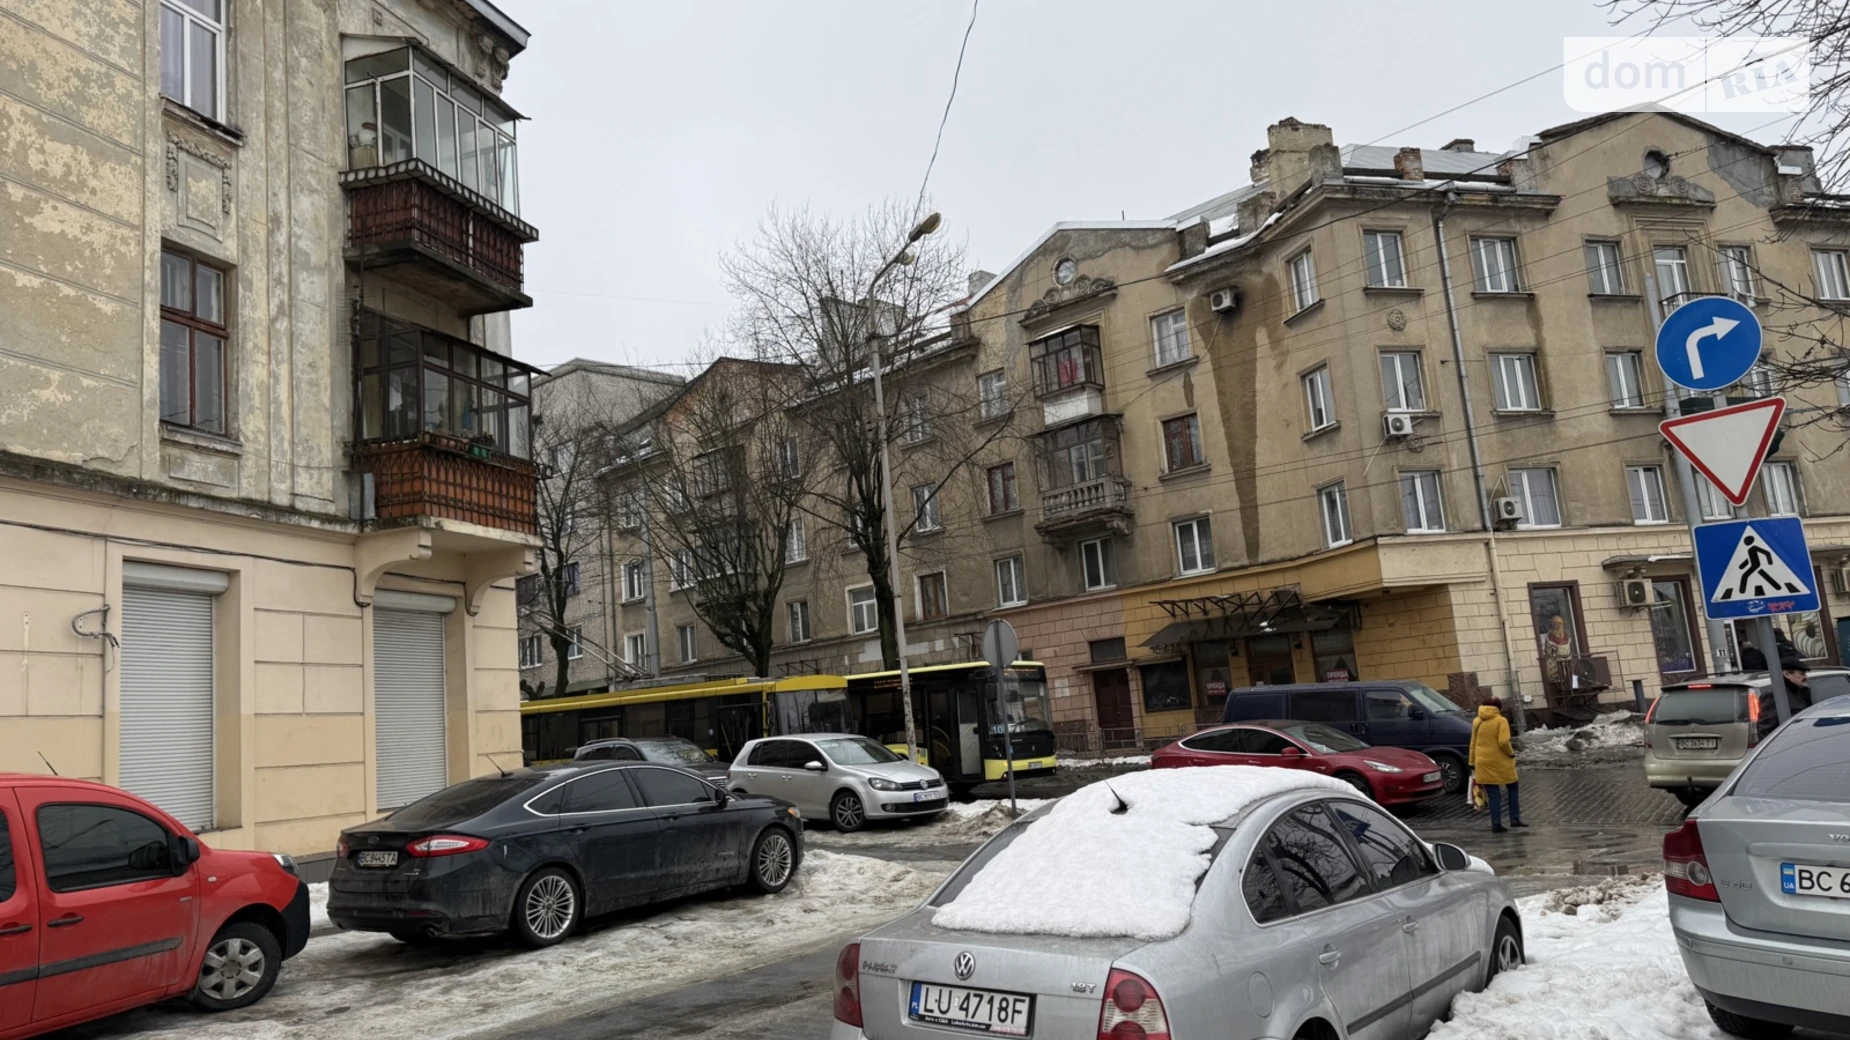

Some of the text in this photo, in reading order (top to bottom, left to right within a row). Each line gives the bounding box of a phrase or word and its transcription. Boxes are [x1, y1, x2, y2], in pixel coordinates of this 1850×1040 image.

[1326, 671, 1349, 679] ОРЕНДА
[923, 986, 1027, 1025] LU 4718F
